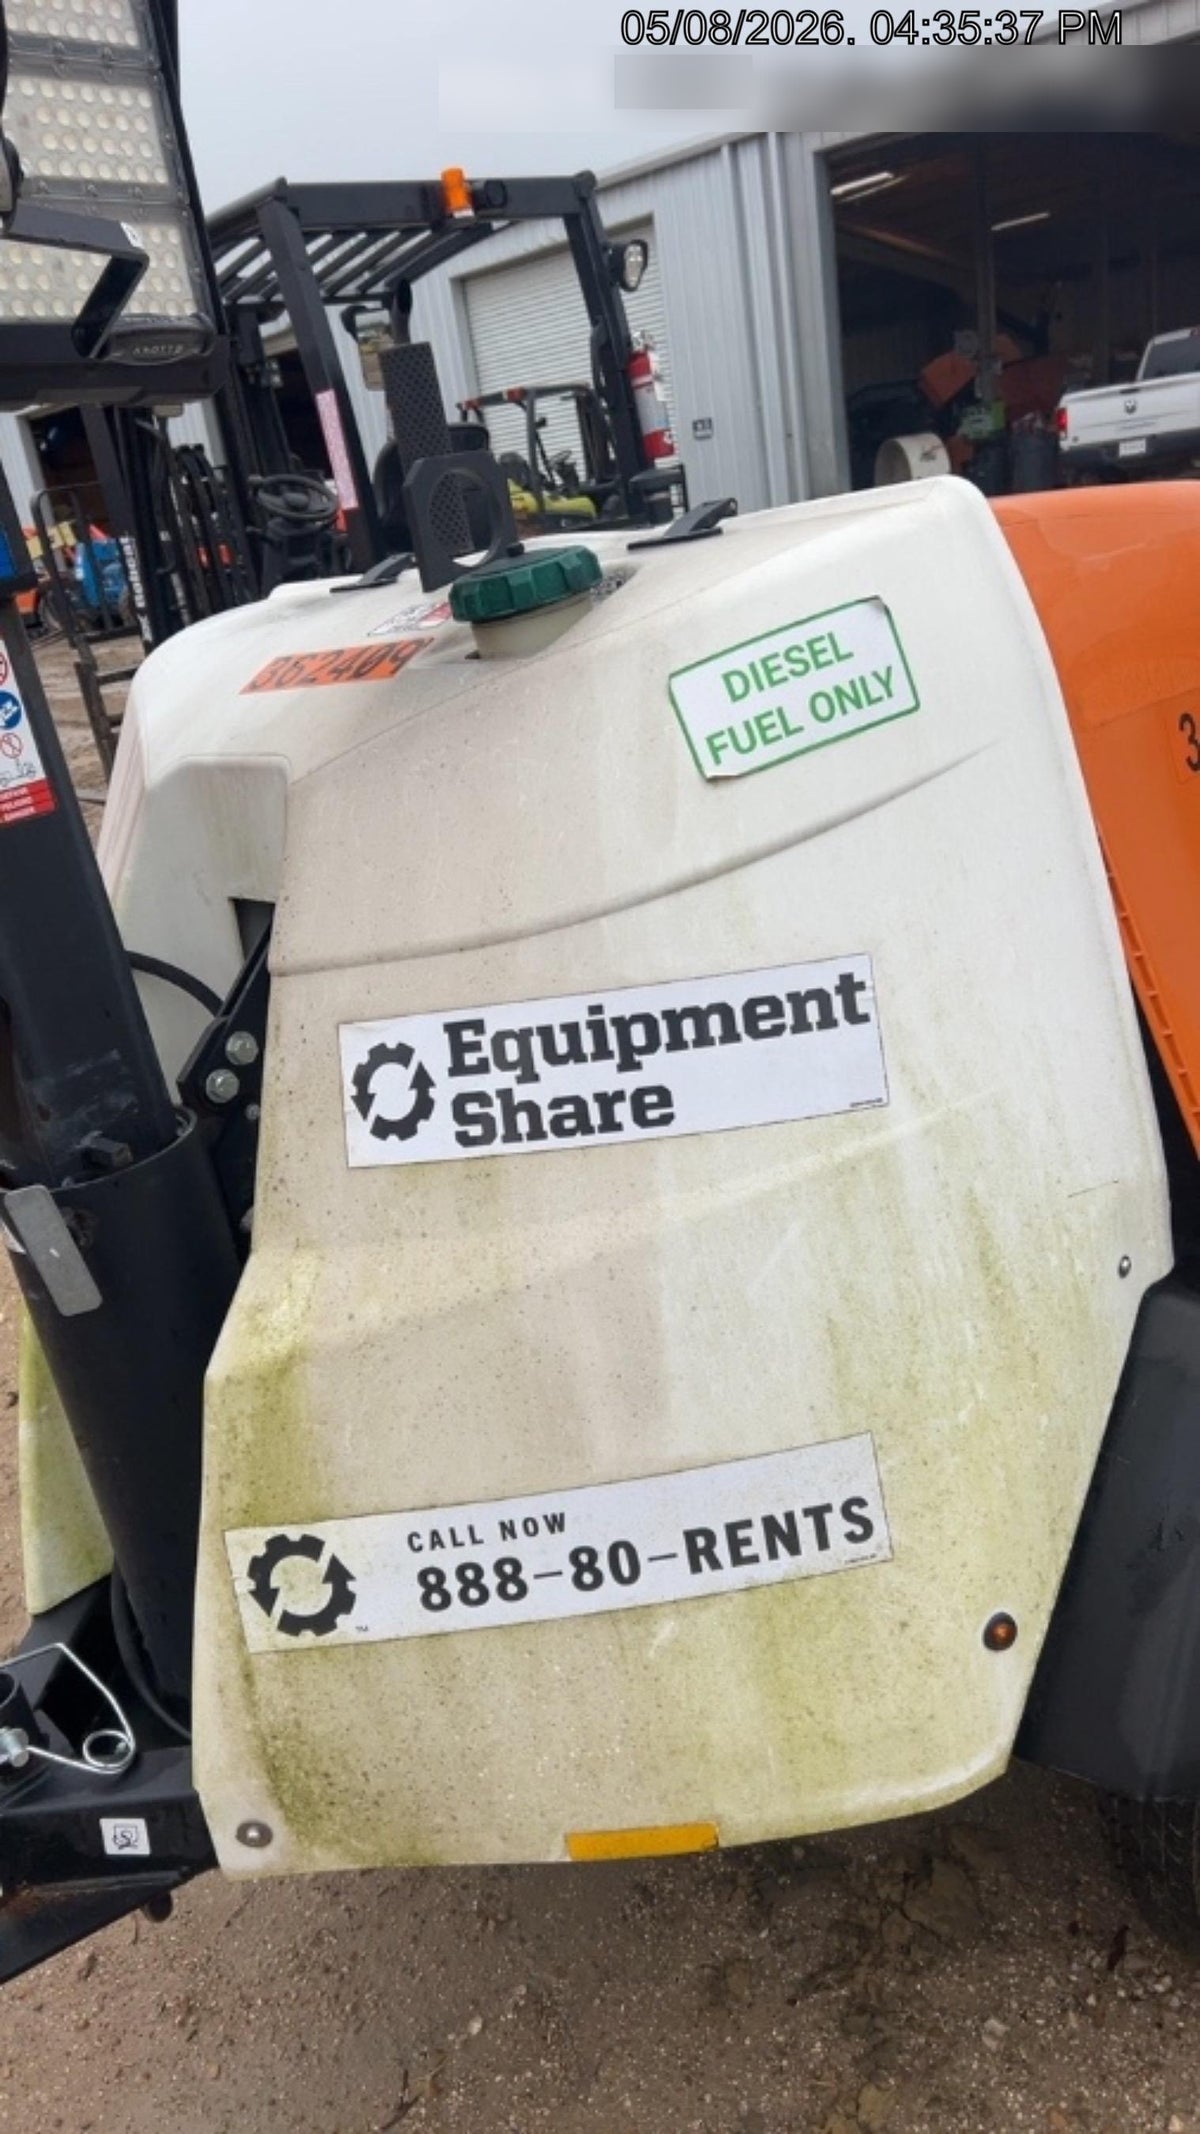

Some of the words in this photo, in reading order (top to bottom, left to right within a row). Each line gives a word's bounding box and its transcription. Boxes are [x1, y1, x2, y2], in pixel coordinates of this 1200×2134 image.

[721, 631, 854, 703] DIESEL
[705, 706, 804, 765] FUEL
[809, 666, 893, 723] ONLY
[443, 972, 871, 1084] Equipment
[451, 1085, 675, 1148] Share
[406, 1522, 484, 1553] CALL
[499, 1511, 568, 1542] NOW
[416, 1497, 875, 1613] 888-80-RENTS
